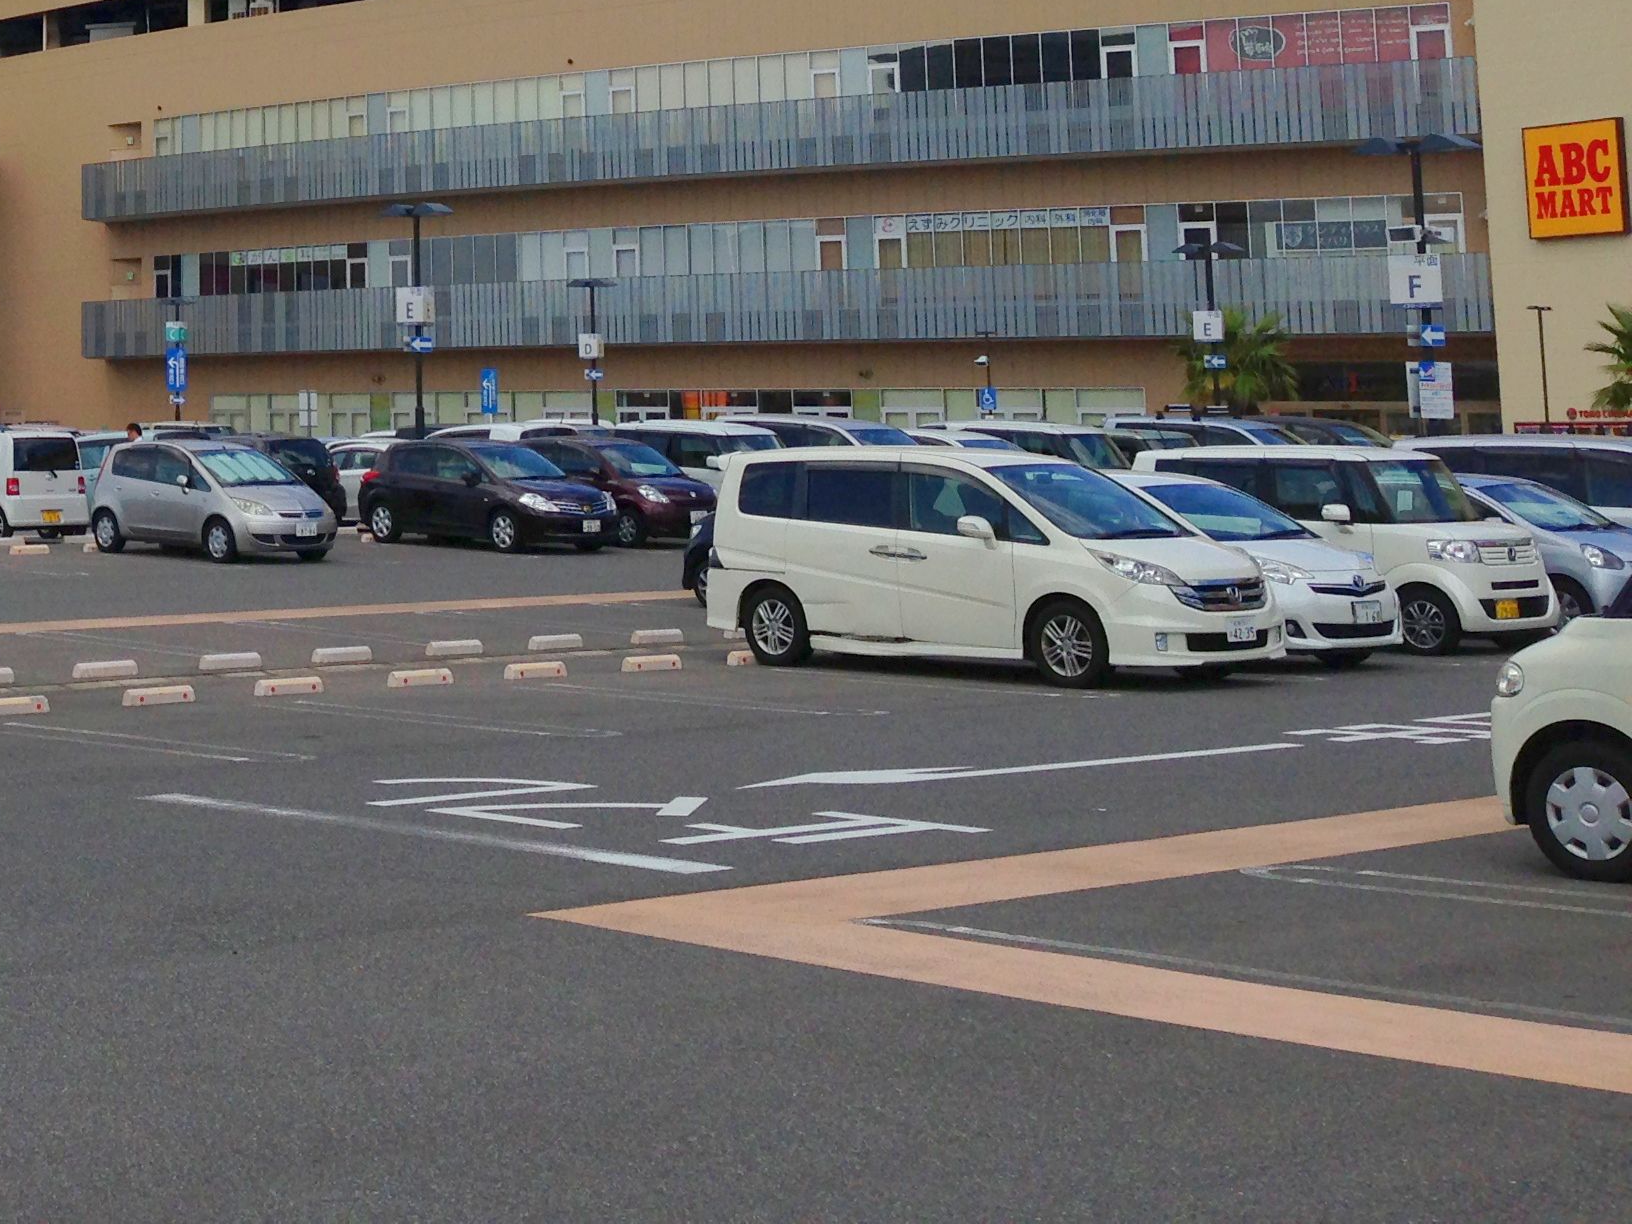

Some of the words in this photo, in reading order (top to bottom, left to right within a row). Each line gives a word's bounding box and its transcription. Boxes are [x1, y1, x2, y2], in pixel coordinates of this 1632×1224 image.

[1534, 138, 1611, 188] ABC
[1535, 186, 1613, 220] MART
[1408, 274, 1422, 299] F
[406, 302, 414, 319] E
[1203, 322, 1212, 337] E
[584, 343, 592, 355] D
